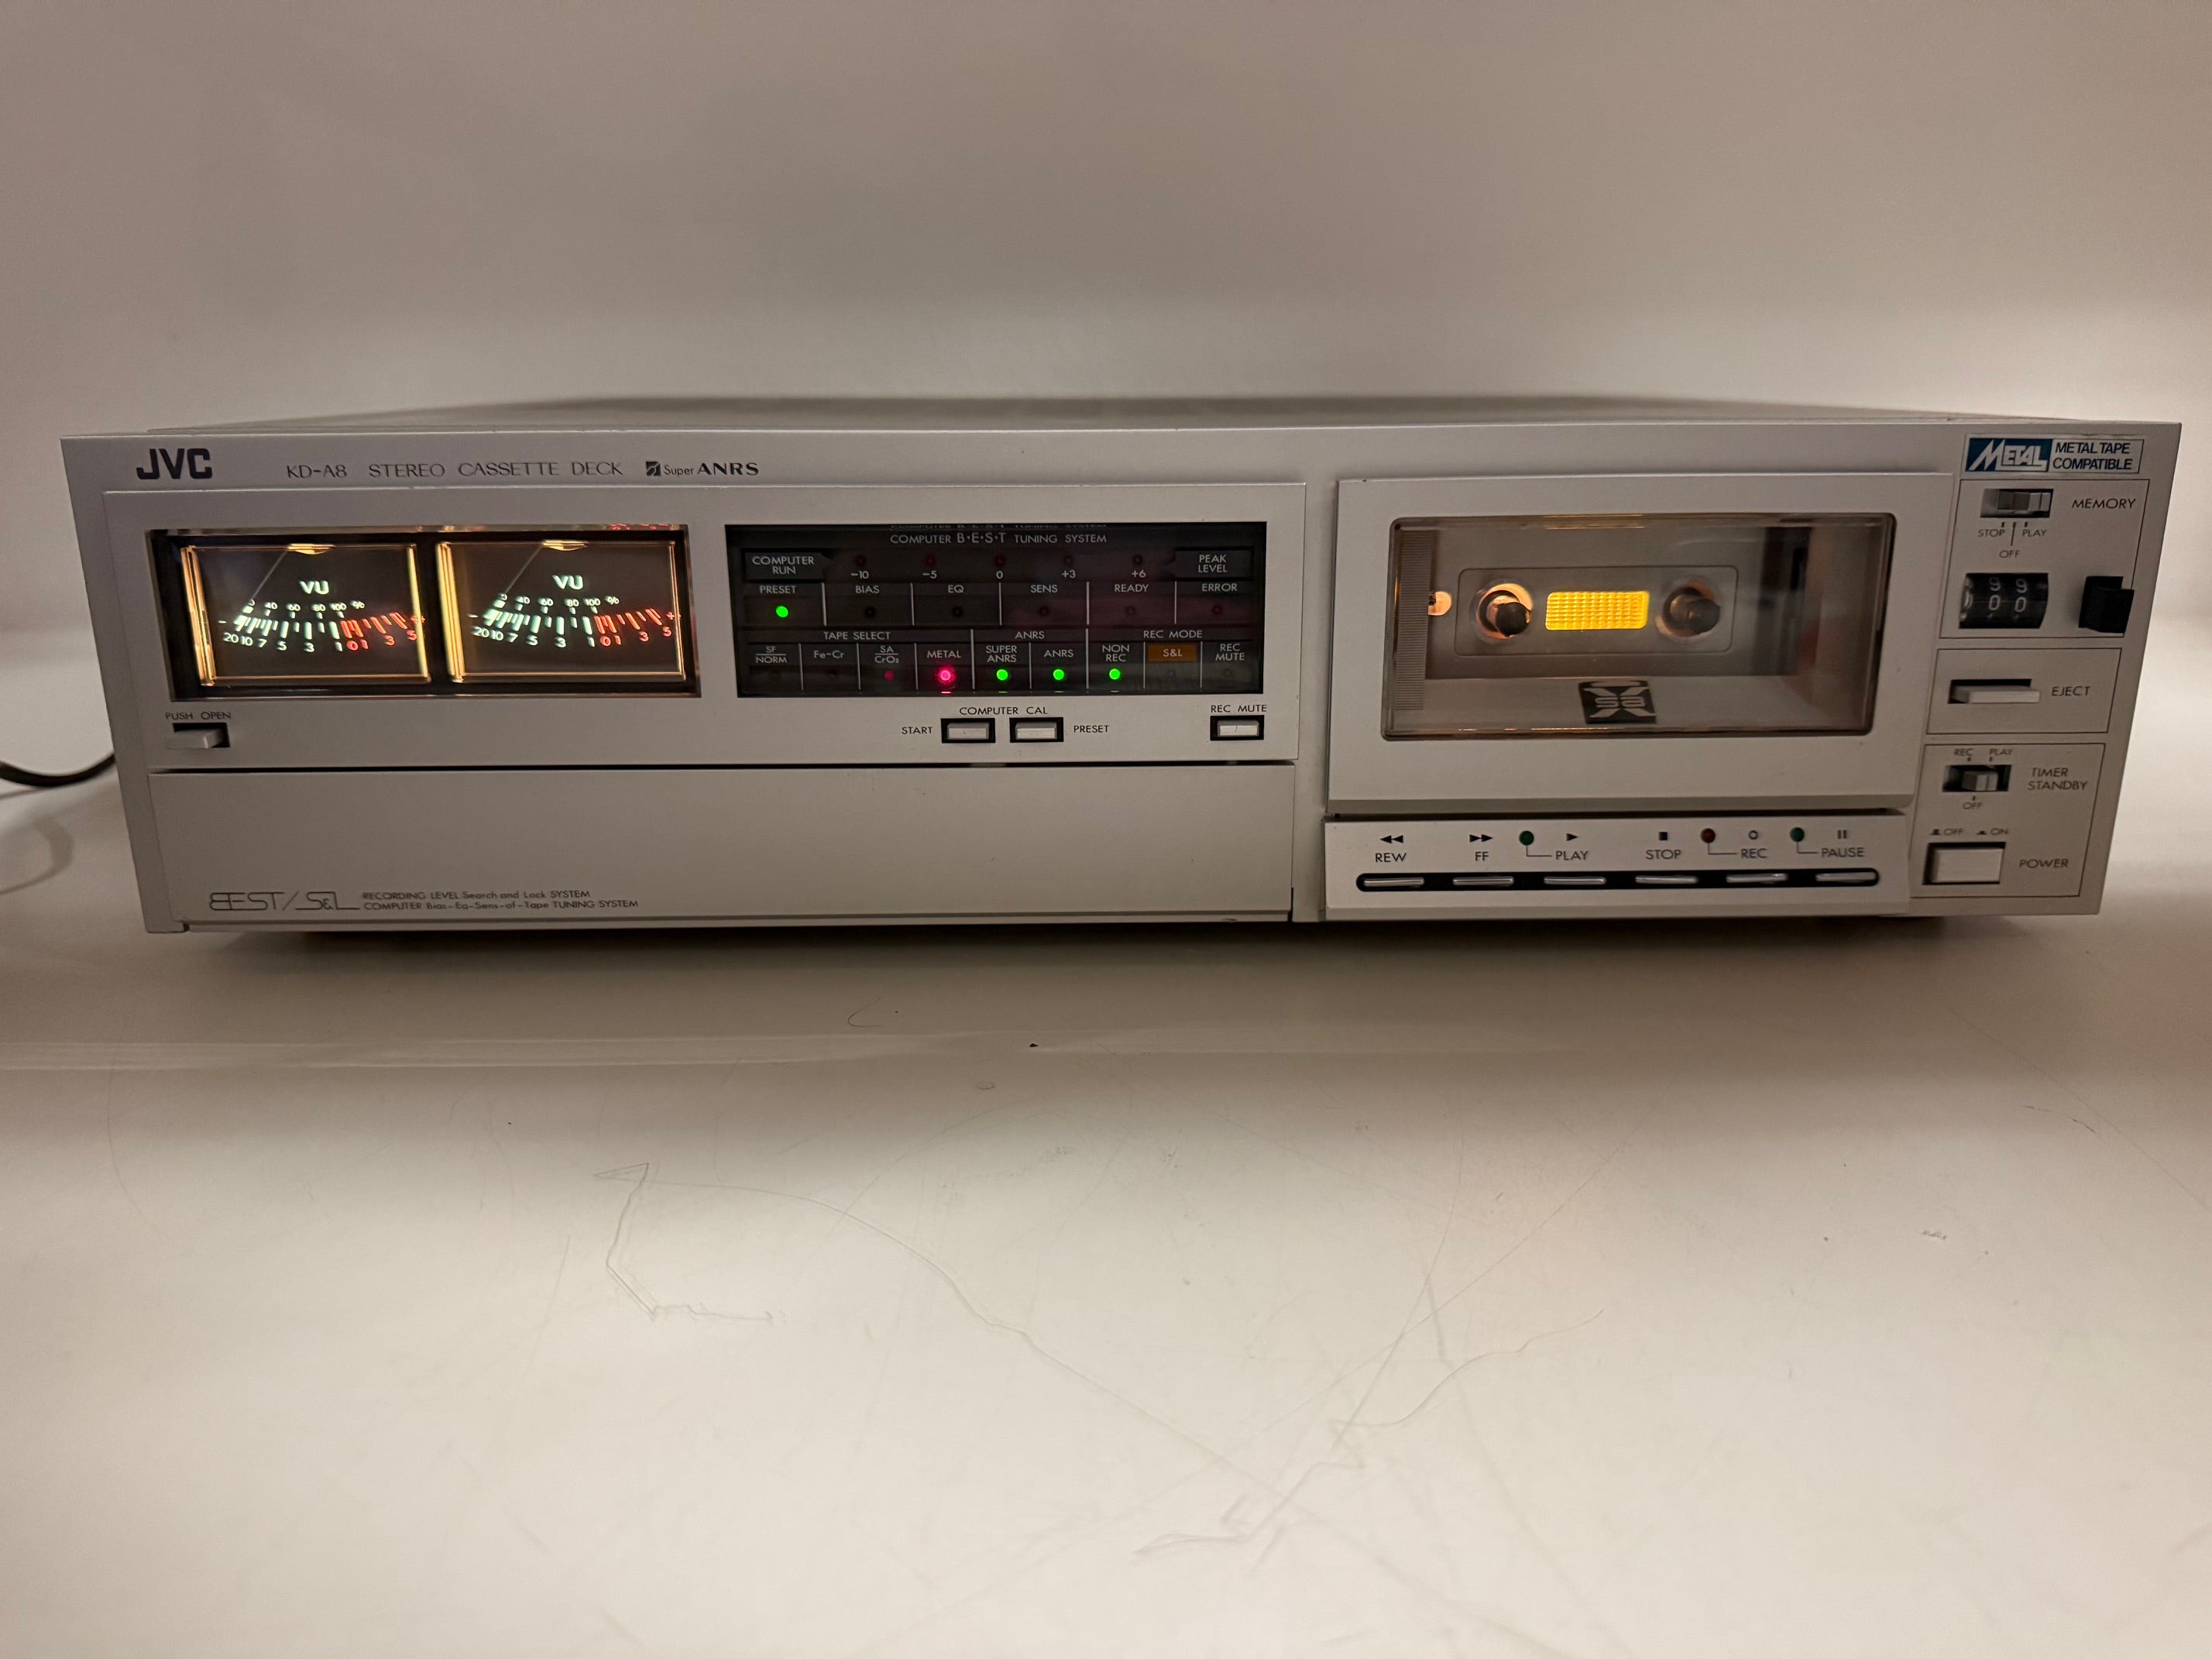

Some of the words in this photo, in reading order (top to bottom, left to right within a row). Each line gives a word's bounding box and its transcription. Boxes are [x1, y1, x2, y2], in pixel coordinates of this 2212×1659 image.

[2055, 442, 2099, 455] METAL
[2099, 442, 2130, 455] TAPE
[1967, 439, 2048, 472] METAL
[136, 448, 213, 480] JVC
[2052, 458, 2133, 470] COMPATIBLE
[286, 463, 348, 479] KD-A8
[368, 463, 445, 478] STEREO
[458, 462, 558, 477] CASSETTE
[572, 461, 623, 476] DECK
[664, 465, 695, 478] Super
[696, 462, 760, 477] ANRS
[2071, 498, 2136, 510] MEMORY
[1977, 529, 2005, 538] STOP
[2022, 529, 2047, 538] PLAY
[889, 534, 952, 544] COMPUTER
[1014, 534, 1059, 544] TUNING
[1064, 534, 1108, 544] SYSTEM
[1998, 549, 2020, 558] OFF
[751, 555, 815, 565] COMPUTER
[1198, 554, 1228, 564] PEAK
[771, 565, 796, 575] RUN
[1197, 564, 1228, 573] LEVEL
[995, 570, 1004, 579] 0
[1061, 569, 1077, 579] +3
[1131, 569, 1147, 579] +6
[299, 580, 329, 595] VU
[552, 575, 584, 590] VU
[759, 584, 797, 594] PRESET
[855, 584, 880, 594] BIAS
[947, 584, 964, 595] EQ
[1030, 583, 1058, 593] SENS
[1114, 583, 1149, 593] READY
[1201, 582, 1238, 592] ERROR
[472, 627, 489, 638] 20
[490, 630, 504, 641] 10
[506, 632, 519, 643] 7
[527, 634, 538, 646] 5
[555, 637, 567, 648] 3
[599, 636, 611, 647] 0
[638, 630, 650, 642] 3
[661, 627, 673, 637] 5
[823, 631, 848, 641] TAPE
[853, 631, 891, 641] SELECT
[1015, 630, 1045, 640] ANRS
[1143, 630, 1165, 639] REC
[1169, 630, 1203, 639] MODE
[224, 633, 239, 644] 20
[241, 636, 253, 647] 10
[257, 639, 267, 648] 7
[276, 641, 287, 651] 5
[304, 642, 315, 653] 3
[347, 640, 359, 651] 0
[384, 634, 395, 646] 3
[1219, 643, 1241, 652] REC
[765, 645, 777, 654] SF
[880, 645, 894, 654] SA
[926, 649, 962, 658] METAL
[985, 644, 1018, 654] SUPER
[1043, 649, 1074, 658] ANRS
[1101, 644, 1130, 653] NON
[1163, 648, 1183, 658] S&L
[813, 650, 845, 659] Fe-Cr
[987, 654, 1017, 663] ANRS
[1105, 653, 1127, 662] REC
[1214, 652, 1245, 661] MUTE
[755, 655, 788, 665] NORM
[2051, 685, 2090, 696] EJECT
[959, 706, 1018, 716] COMPUTER
[1025, 706, 1048, 715] CAL
[1210, 704, 1234, 713] REC
[1238, 703, 1267, 713] MUTE
[165, 712, 194, 720] PUSH
[201, 711, 232, 720] OPEN
[901, 726, 933, 735] START
[1073, 725, 1110, 733] PRESET
[1953, 748, 1973, 757] REC
[2032, 767, 2069, 778] TIMER
[2027, 780, 2088, 791] STANDBY
[1963, 802, 1984, 810] OFF
[1943, 827, 1964, 836] OFF
[1990, 827, 2009, 836] ON
[1375, 852, 1407, 863] REW
[1475, 851, 1489, 862] FF
[1555, 850, 1589, 861] PLAY
[1645, 849, 1681, 860] STOP
[1740, 848, 1768, 859] REC
[1821, 847, 1864, 858] PAUSE
[2018, 859, 2069, 869] POWER
[362, 891, 426, 900] RECORDING
[431, 891, 459, 899] LEVEL
[462, 891, 497, 899] Search
[500, 891, 520, 899] and
[524, 890, 546, 898] Lock
[551, 890, 590, 898] SYSTEM
[363, 902, 422, 911] COMPUTER
[552, 900, 596, 908] TUNING
[599, 899, 639, 908] SYSTEM
